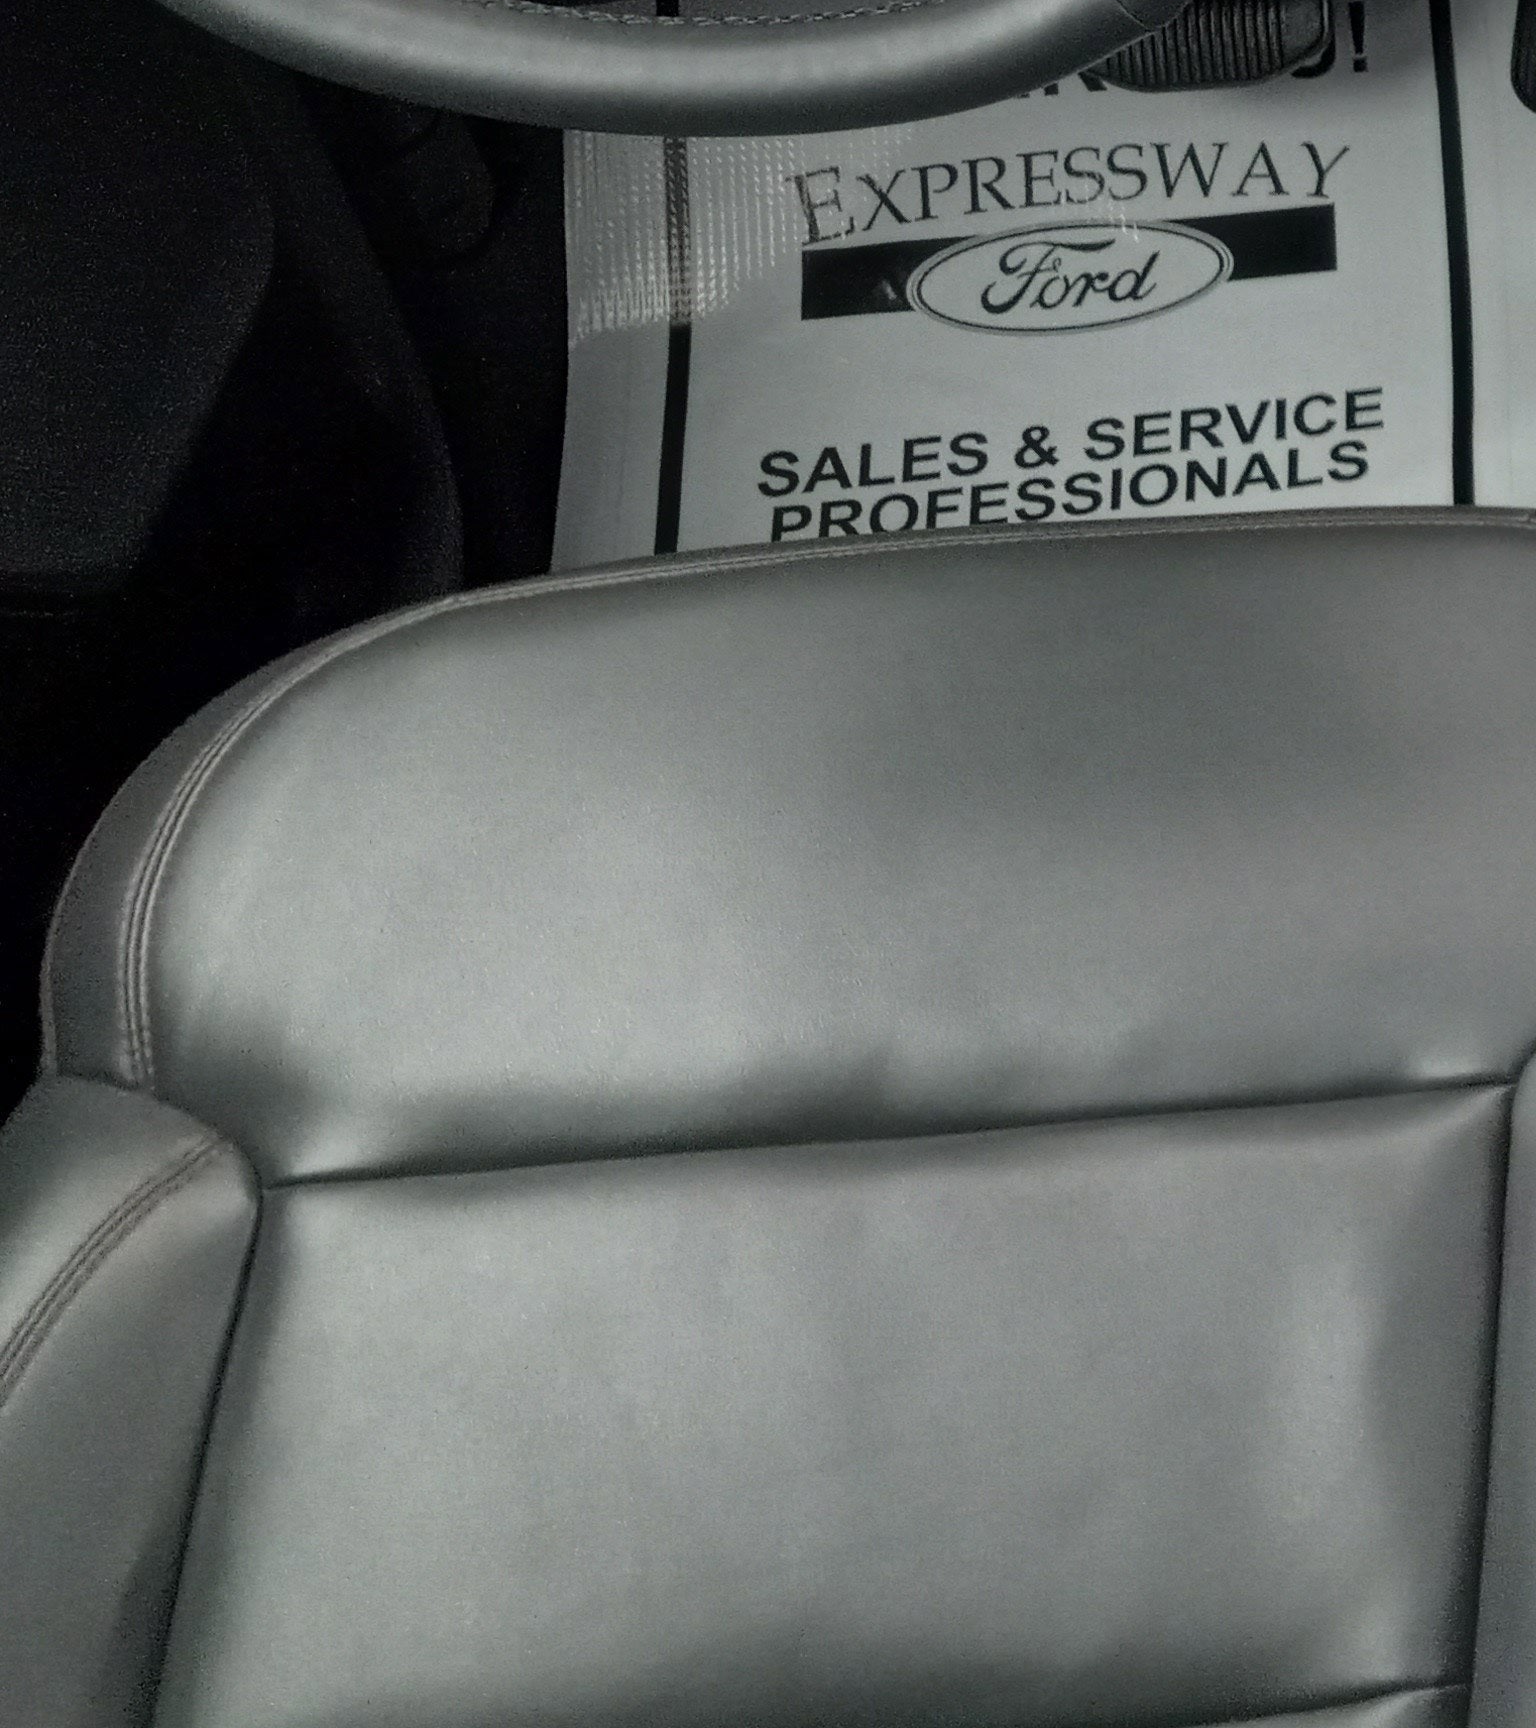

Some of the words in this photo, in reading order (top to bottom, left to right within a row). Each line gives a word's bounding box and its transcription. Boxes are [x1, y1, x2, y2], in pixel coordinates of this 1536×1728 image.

[979, 239, 1158, 313] Ford
[757, 430, 989, 499] SALES
[1012, 423, 1060, 470] &
[1083, 387, 1385, 462] SERVICE
[769, 440, 1369, 542] PROFESSIONALS
